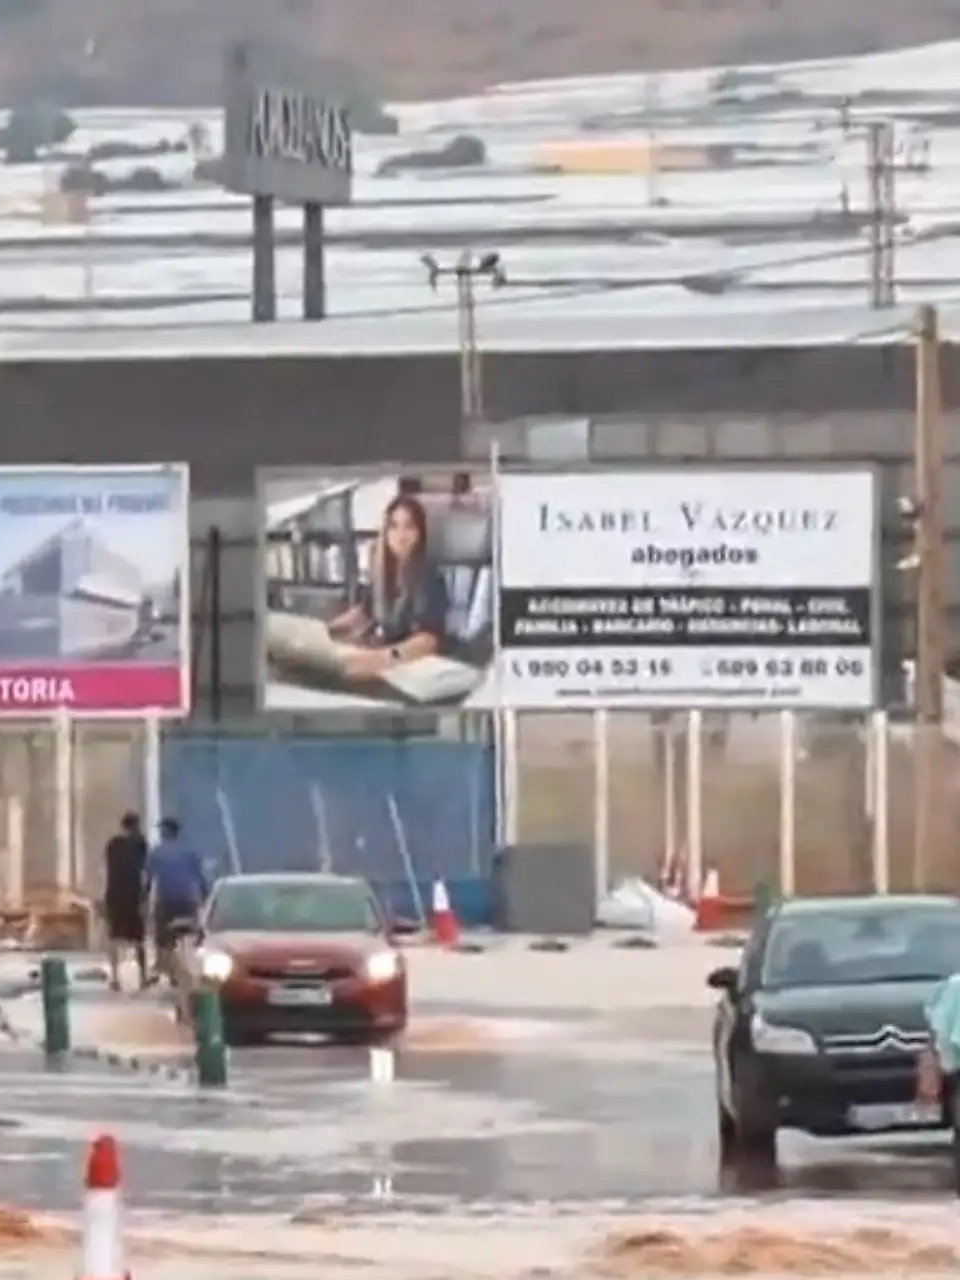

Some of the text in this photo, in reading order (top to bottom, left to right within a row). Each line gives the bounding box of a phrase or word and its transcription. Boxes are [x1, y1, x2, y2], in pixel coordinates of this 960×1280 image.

[540, 502, 660, 532] ISABEL
[632, 544, 758, 568] abogados
[514, 617, 579, 635] FAMILIA
